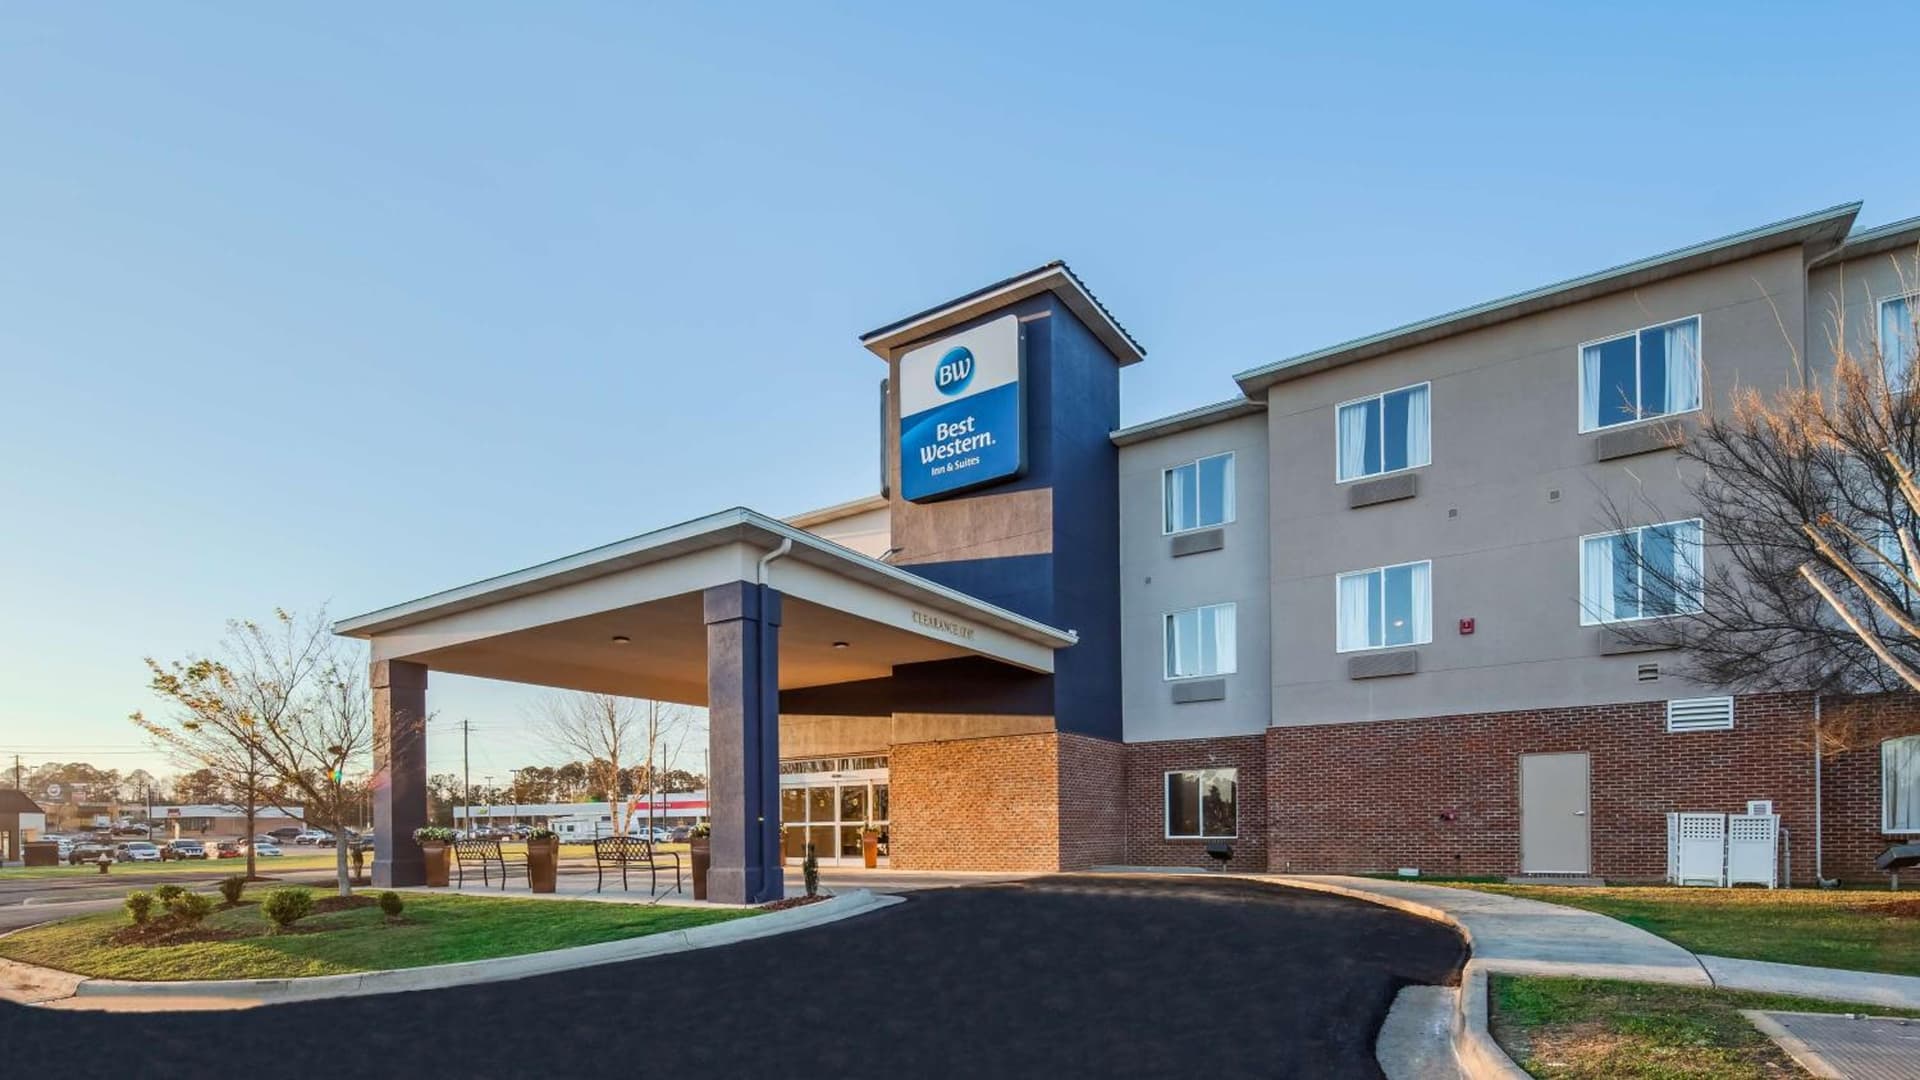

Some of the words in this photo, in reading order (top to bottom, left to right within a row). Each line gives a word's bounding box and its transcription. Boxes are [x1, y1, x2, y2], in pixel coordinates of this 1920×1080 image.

[939, 358, 971, 386] BW
[936, 415, 975, 441] Best
[931, 466, 945, 477] Inn
[946, 462, 954, 472] &
[954, 456, 980, 470] Suites
